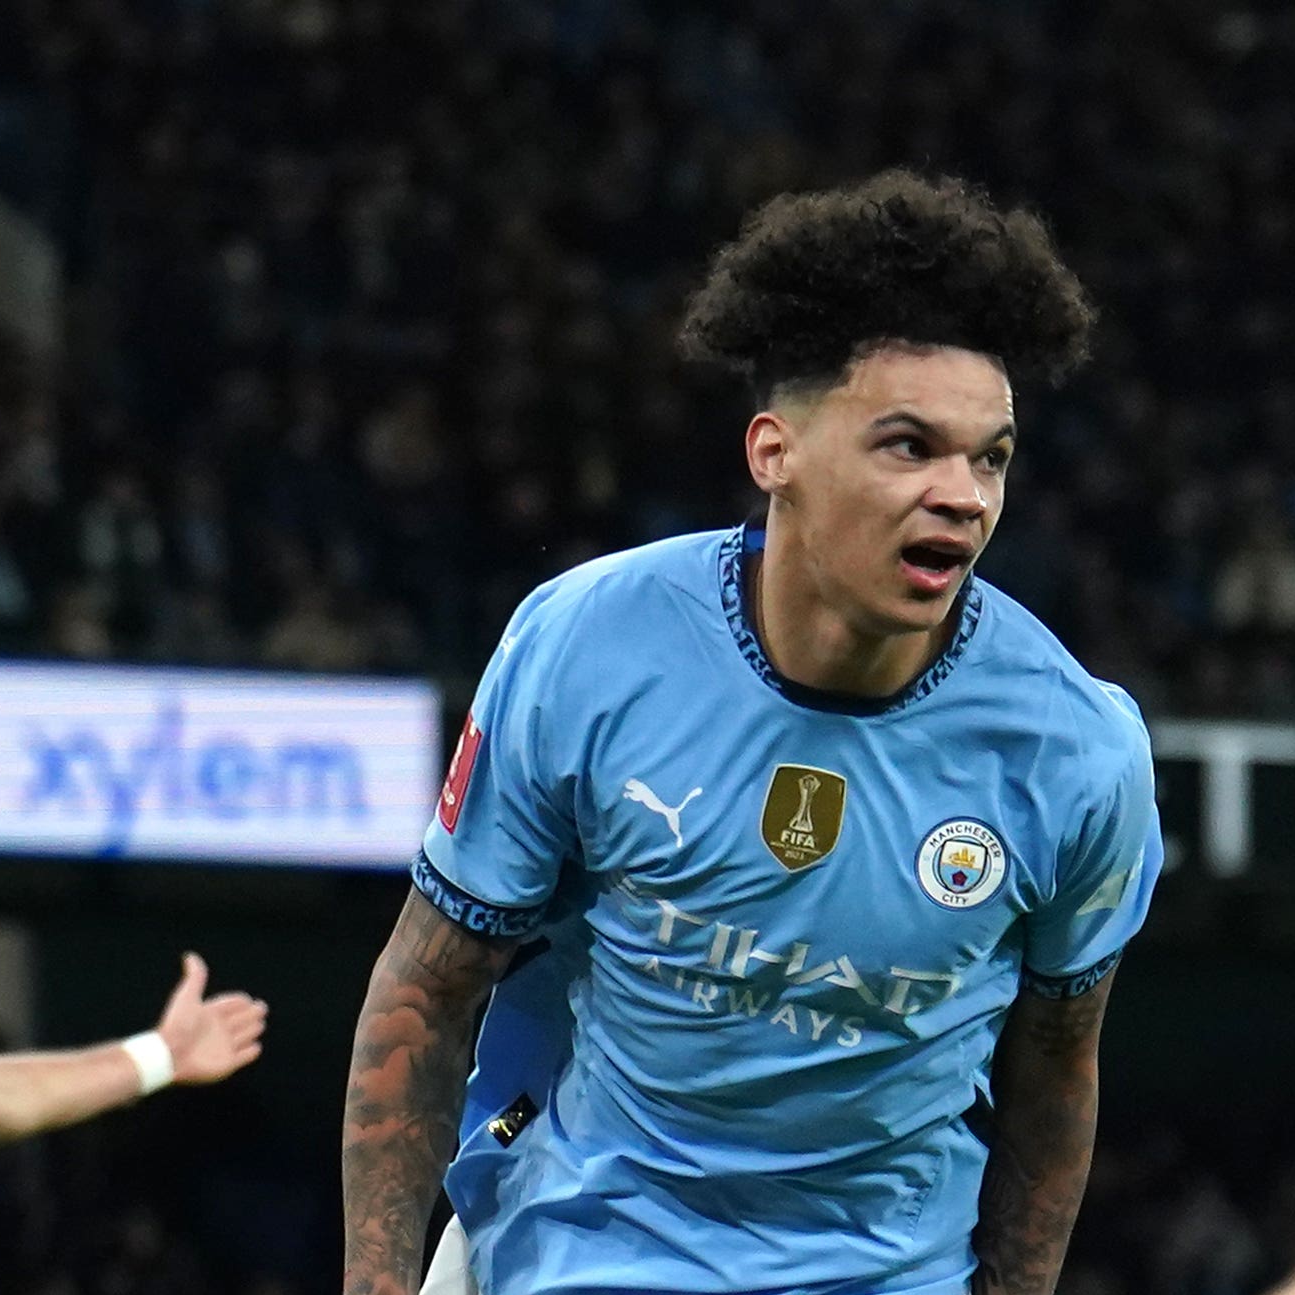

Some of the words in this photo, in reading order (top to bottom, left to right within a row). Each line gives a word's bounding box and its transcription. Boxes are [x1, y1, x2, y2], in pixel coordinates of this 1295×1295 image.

[23, 688, 375, 858] xylem
[780, 829, 816, 849] FIFA
[929, 824, 1002, 858] MANCHESTER
[941, 893, 970, 906] CITY
[641, 956, 866, 1049] AIRWAYS
